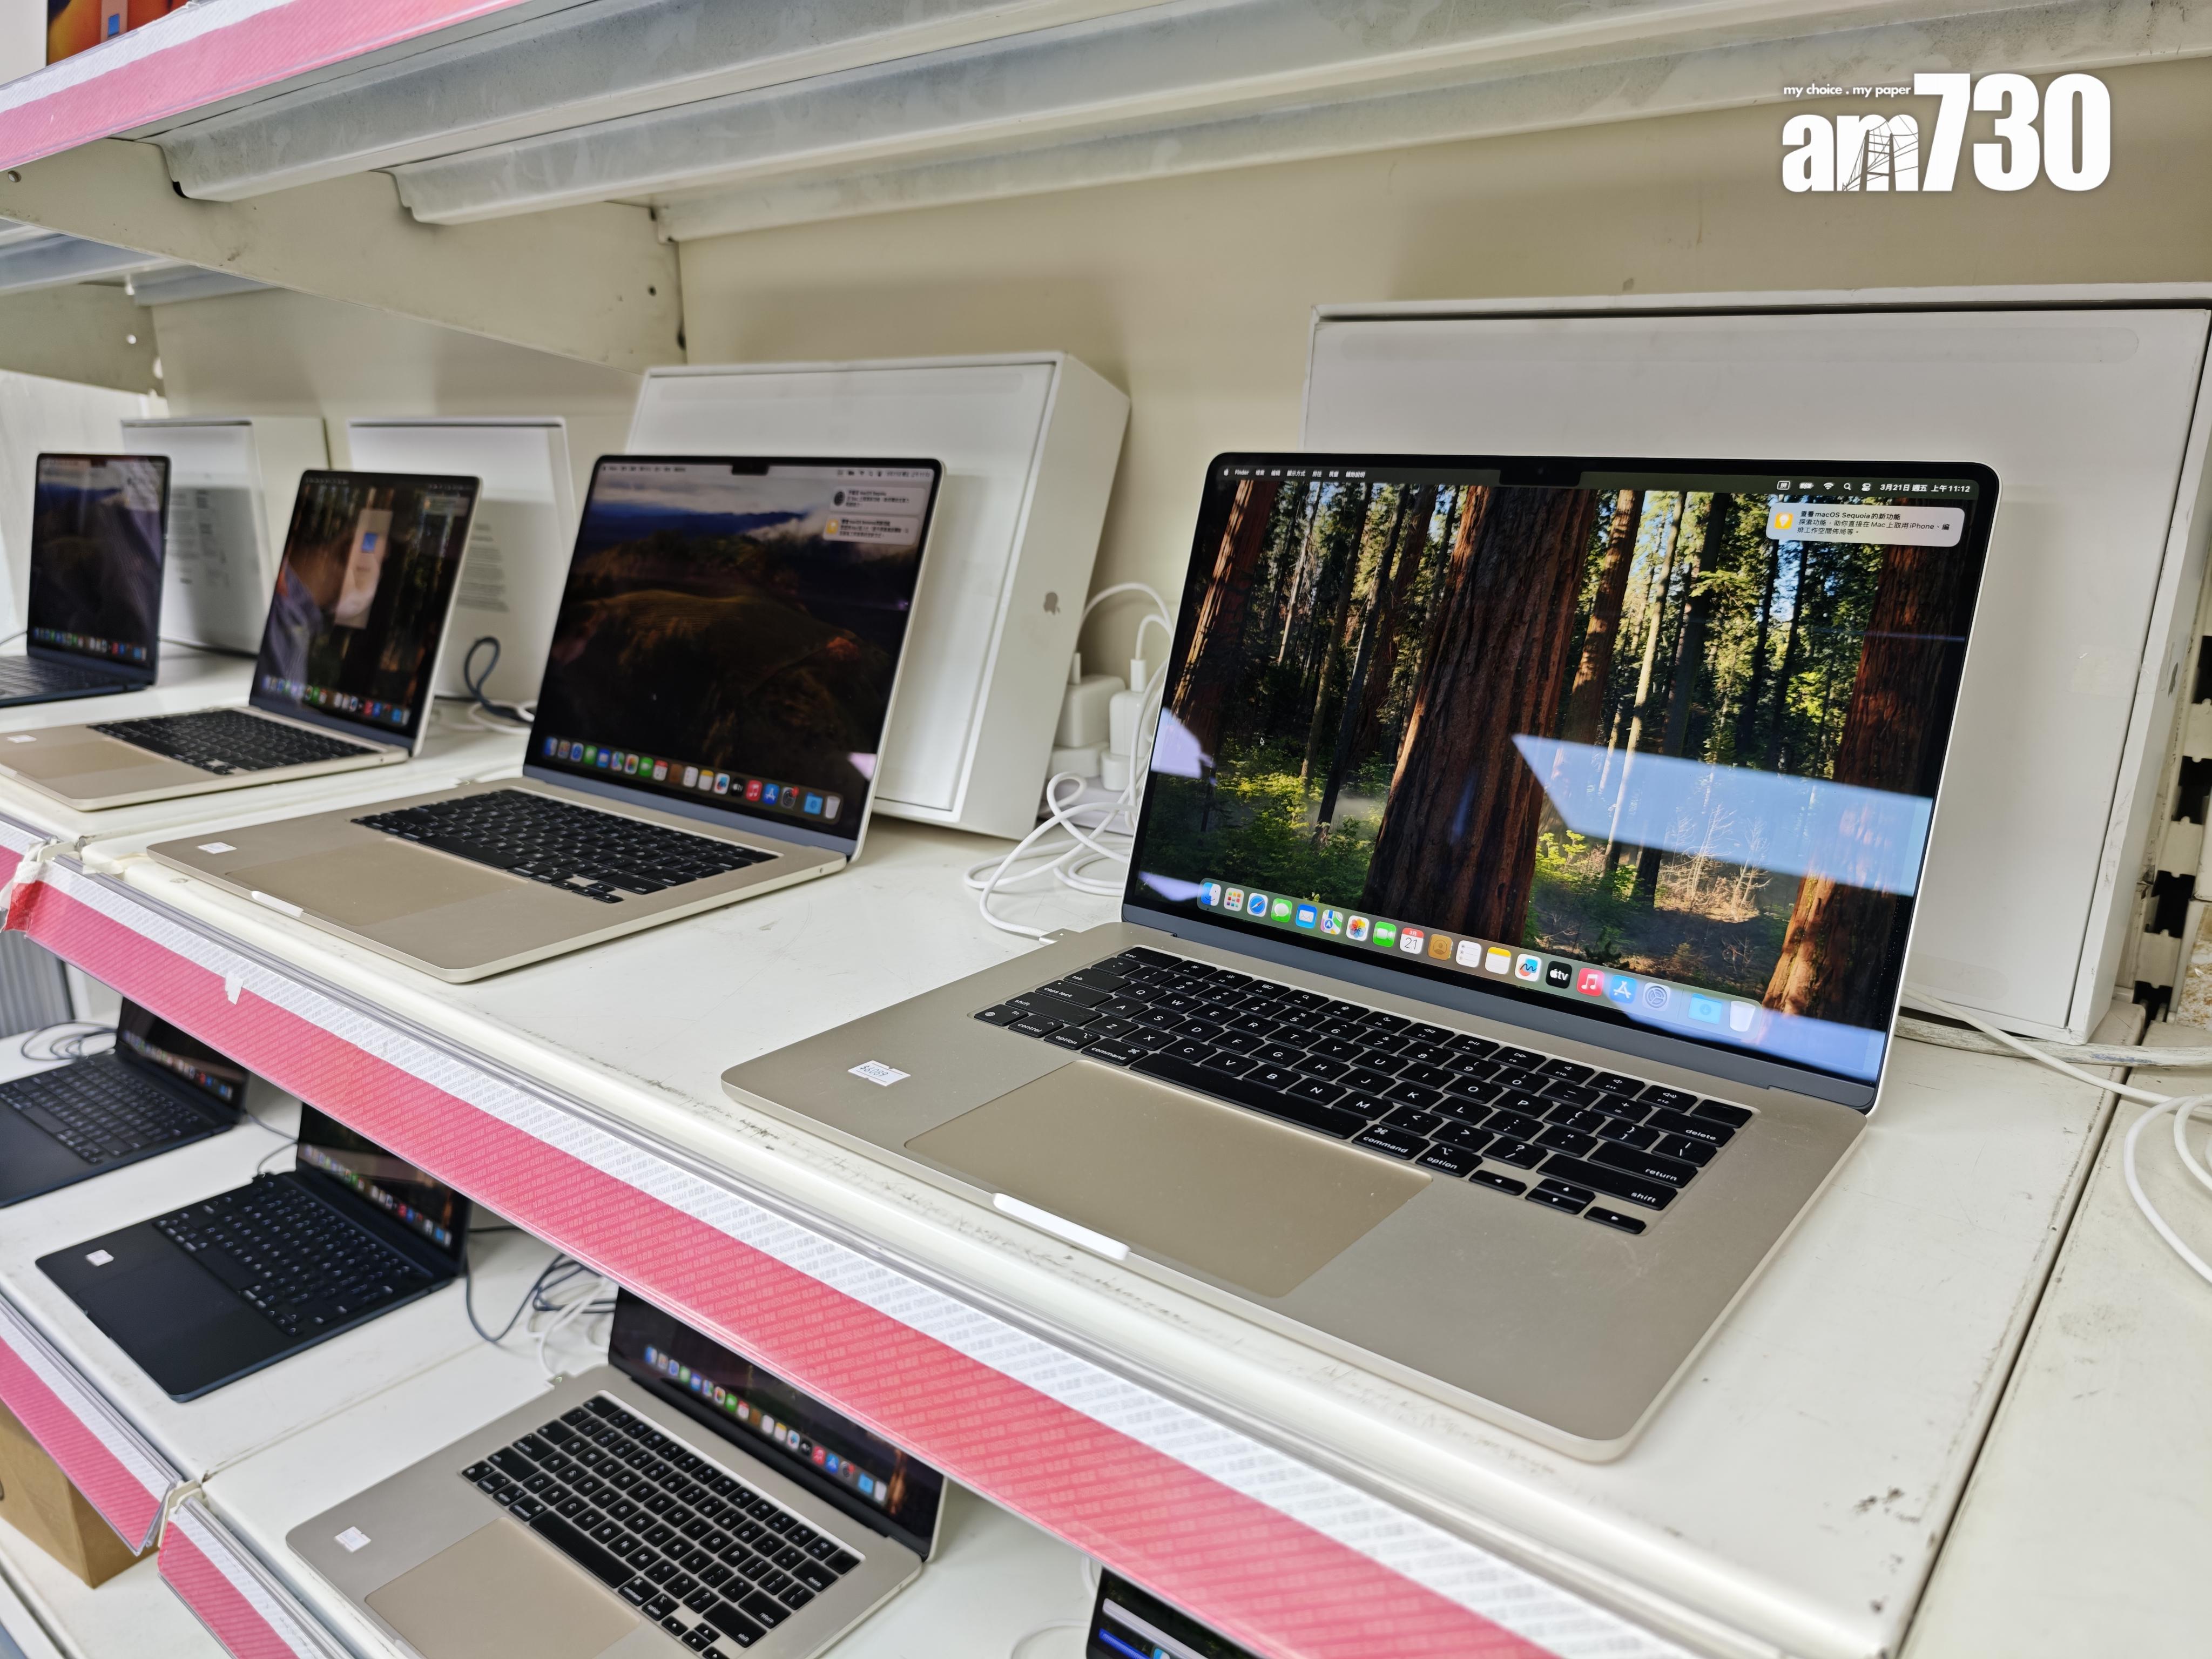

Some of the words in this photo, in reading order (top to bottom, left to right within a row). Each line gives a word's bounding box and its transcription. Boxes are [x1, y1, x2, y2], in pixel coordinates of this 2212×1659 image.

[1405, 937, 1418, 949] 21
[1017, 1023, 1043, 1033] control
[1055, 1035, 1078, 1045] option
[1090, 1047, 1127, 1061] command
[1355, 1101, 1371, 1109] M
[1685, 1129, 1716, 1141] delete
[1363, 1135, 1409, 1154] command
[1426, 1156, 1458, 1170] option
[1644, 1168, 1678, 1181] return
[1630, 1191, 1657, 1204] shift
